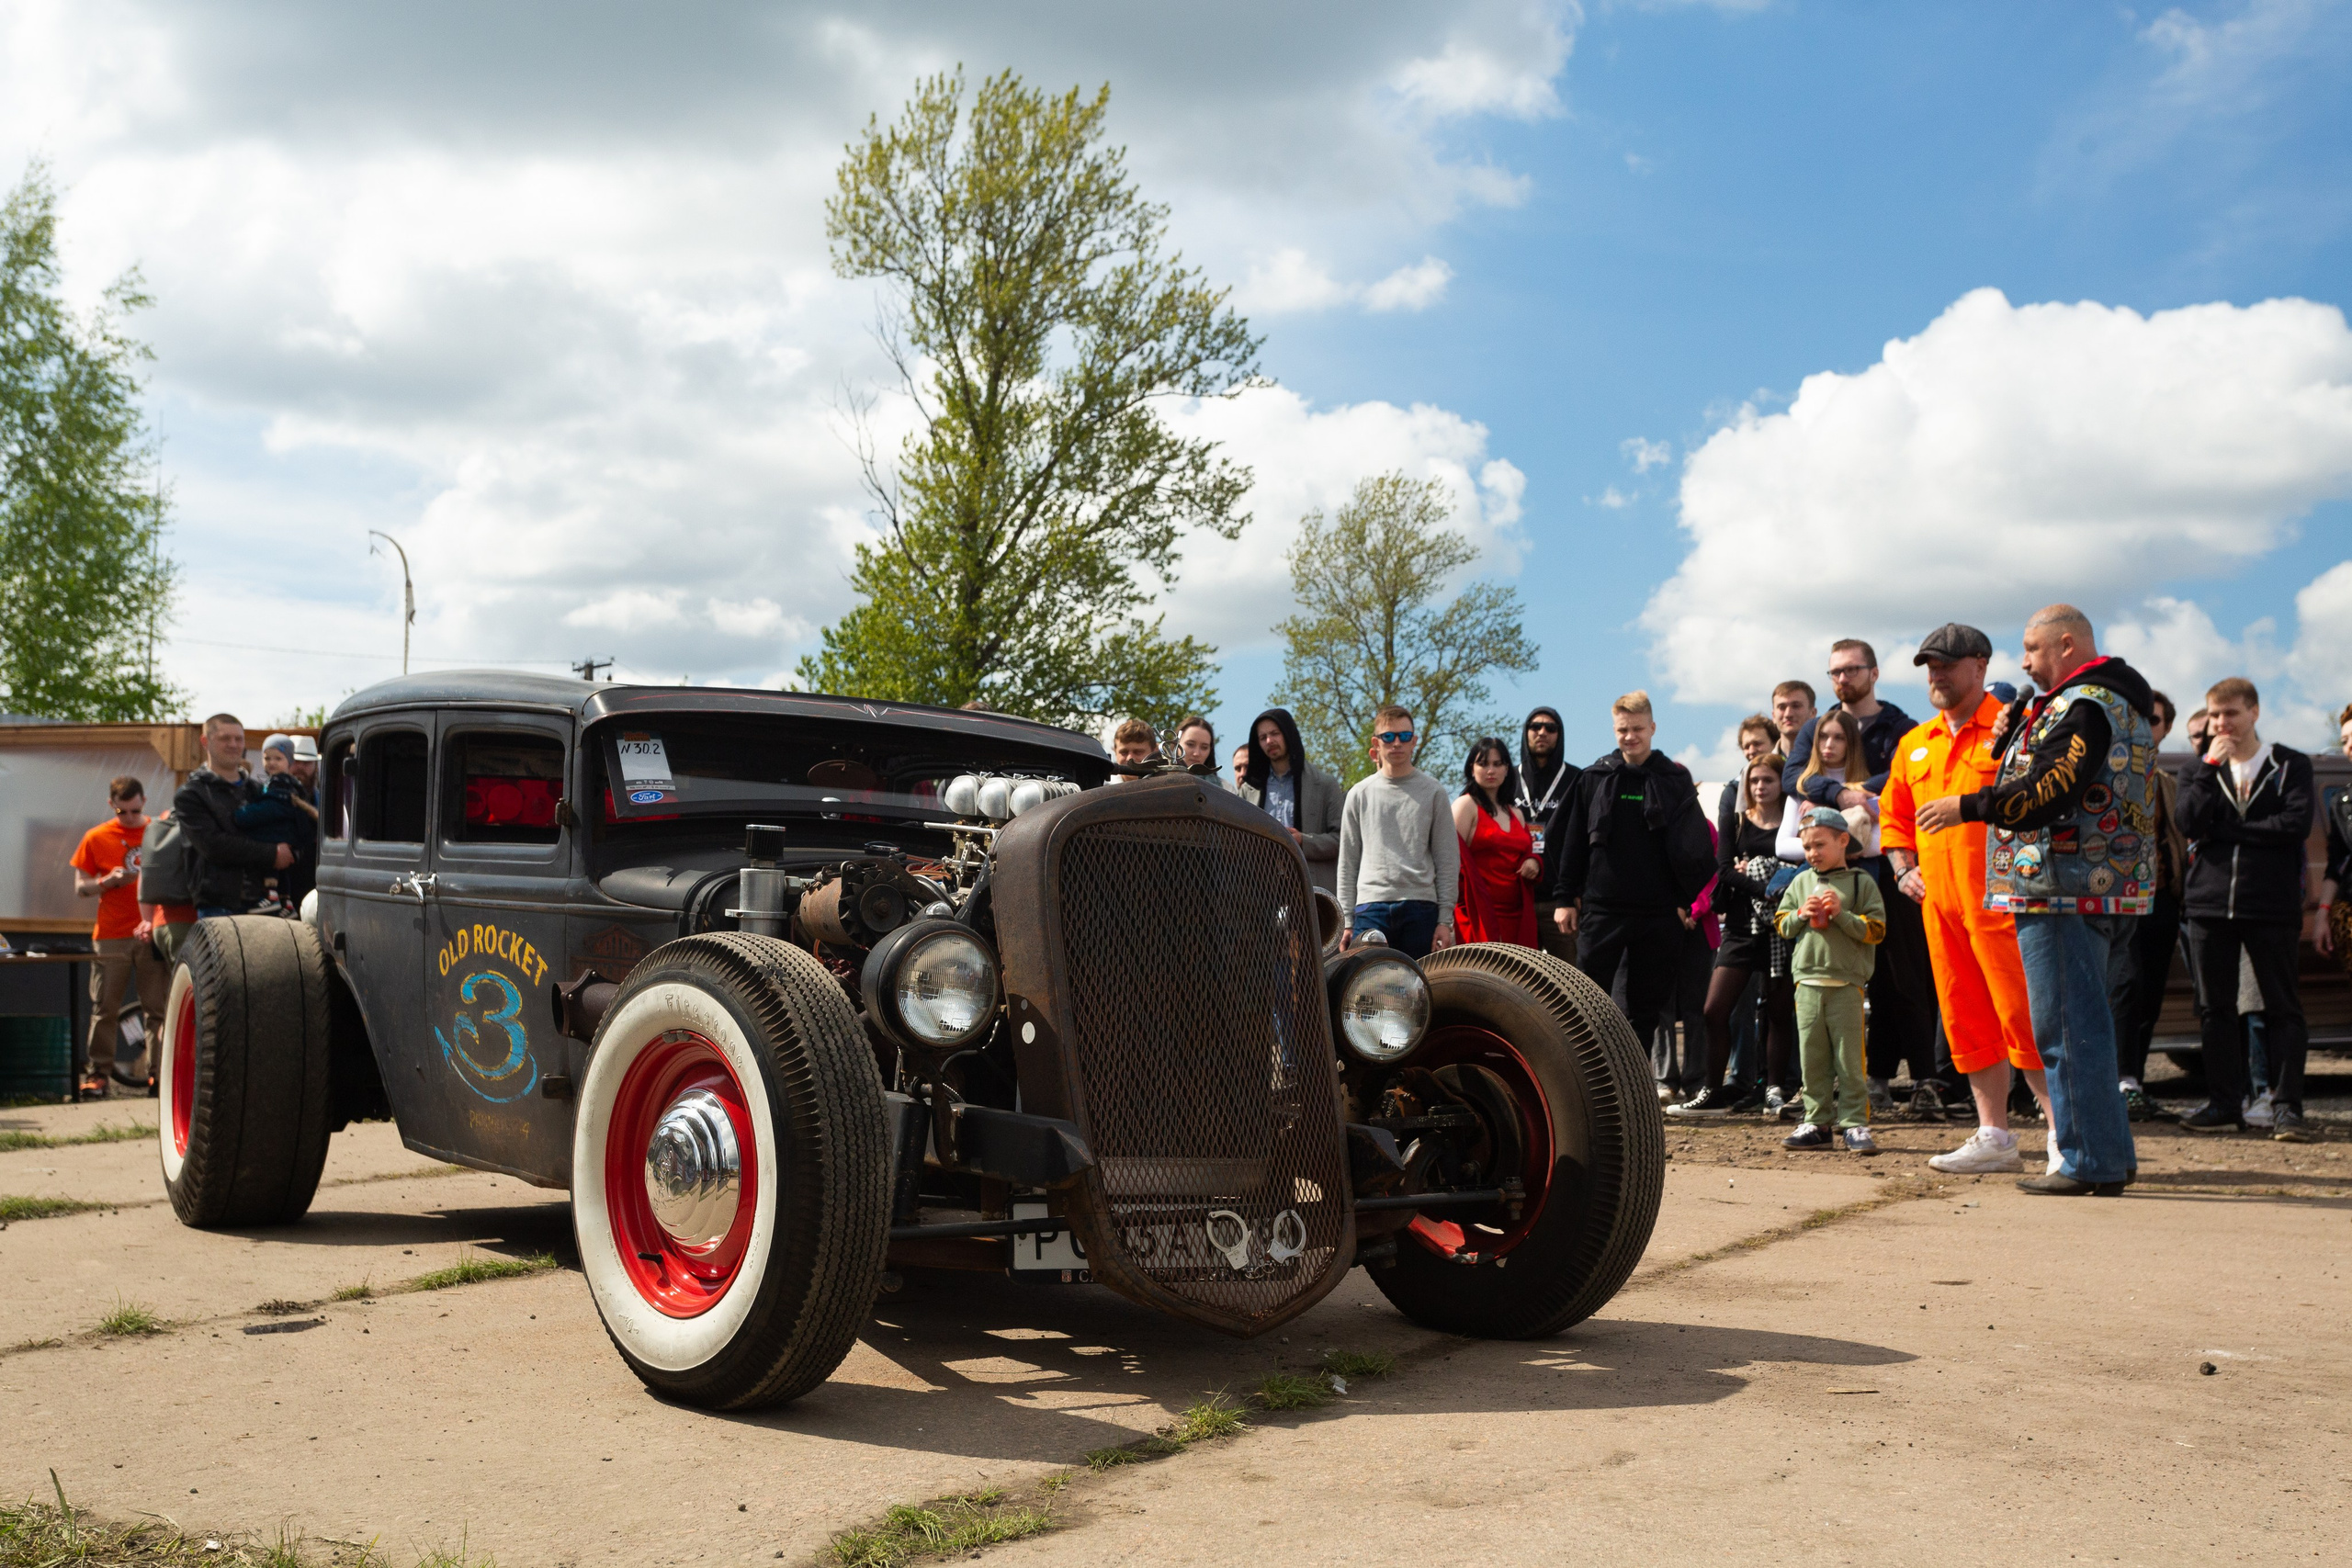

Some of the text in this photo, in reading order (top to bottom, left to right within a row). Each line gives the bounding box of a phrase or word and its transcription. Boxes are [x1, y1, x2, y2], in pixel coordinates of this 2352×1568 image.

[438, 923, 548, 987] OLD ROCKET
[453, 969, 529, 1081] 3
[664, 993, 743, 1068] Firestone
